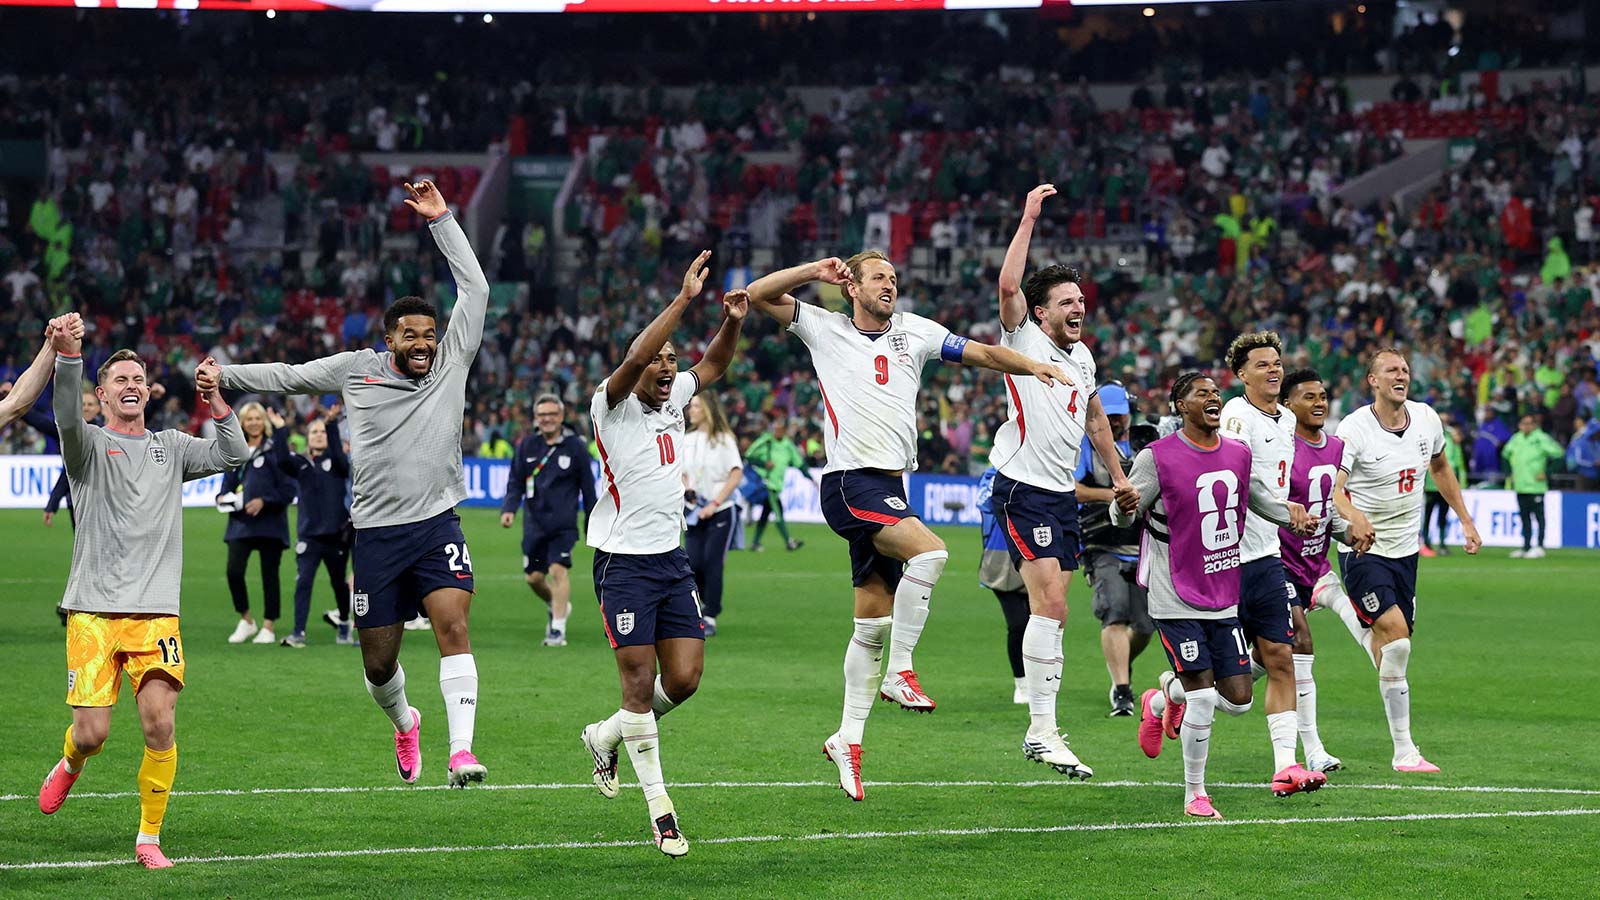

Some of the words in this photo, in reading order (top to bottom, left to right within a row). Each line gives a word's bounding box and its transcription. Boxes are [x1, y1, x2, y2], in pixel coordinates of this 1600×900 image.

[874, 355, 889, 385] 9
[1067, 390, 1078, 418] 4
[656, 433, 675, 465] 10
[1278, 460, 1286, 487] 3
[1398, 468, 1416, 493] 15
[1491, 511, 1521, 536] FIF
[1214, 532, 1230, 543] FIFA
[444, 543, 472, 572] 24
[1203, 551, 1227, 563] WORLD
[1204, 556, 1240, 574] 2026
[691, 590, 702, 618] 1
[157, 636, 180, 664] 13
[460, 697, 475, 706] ENG
